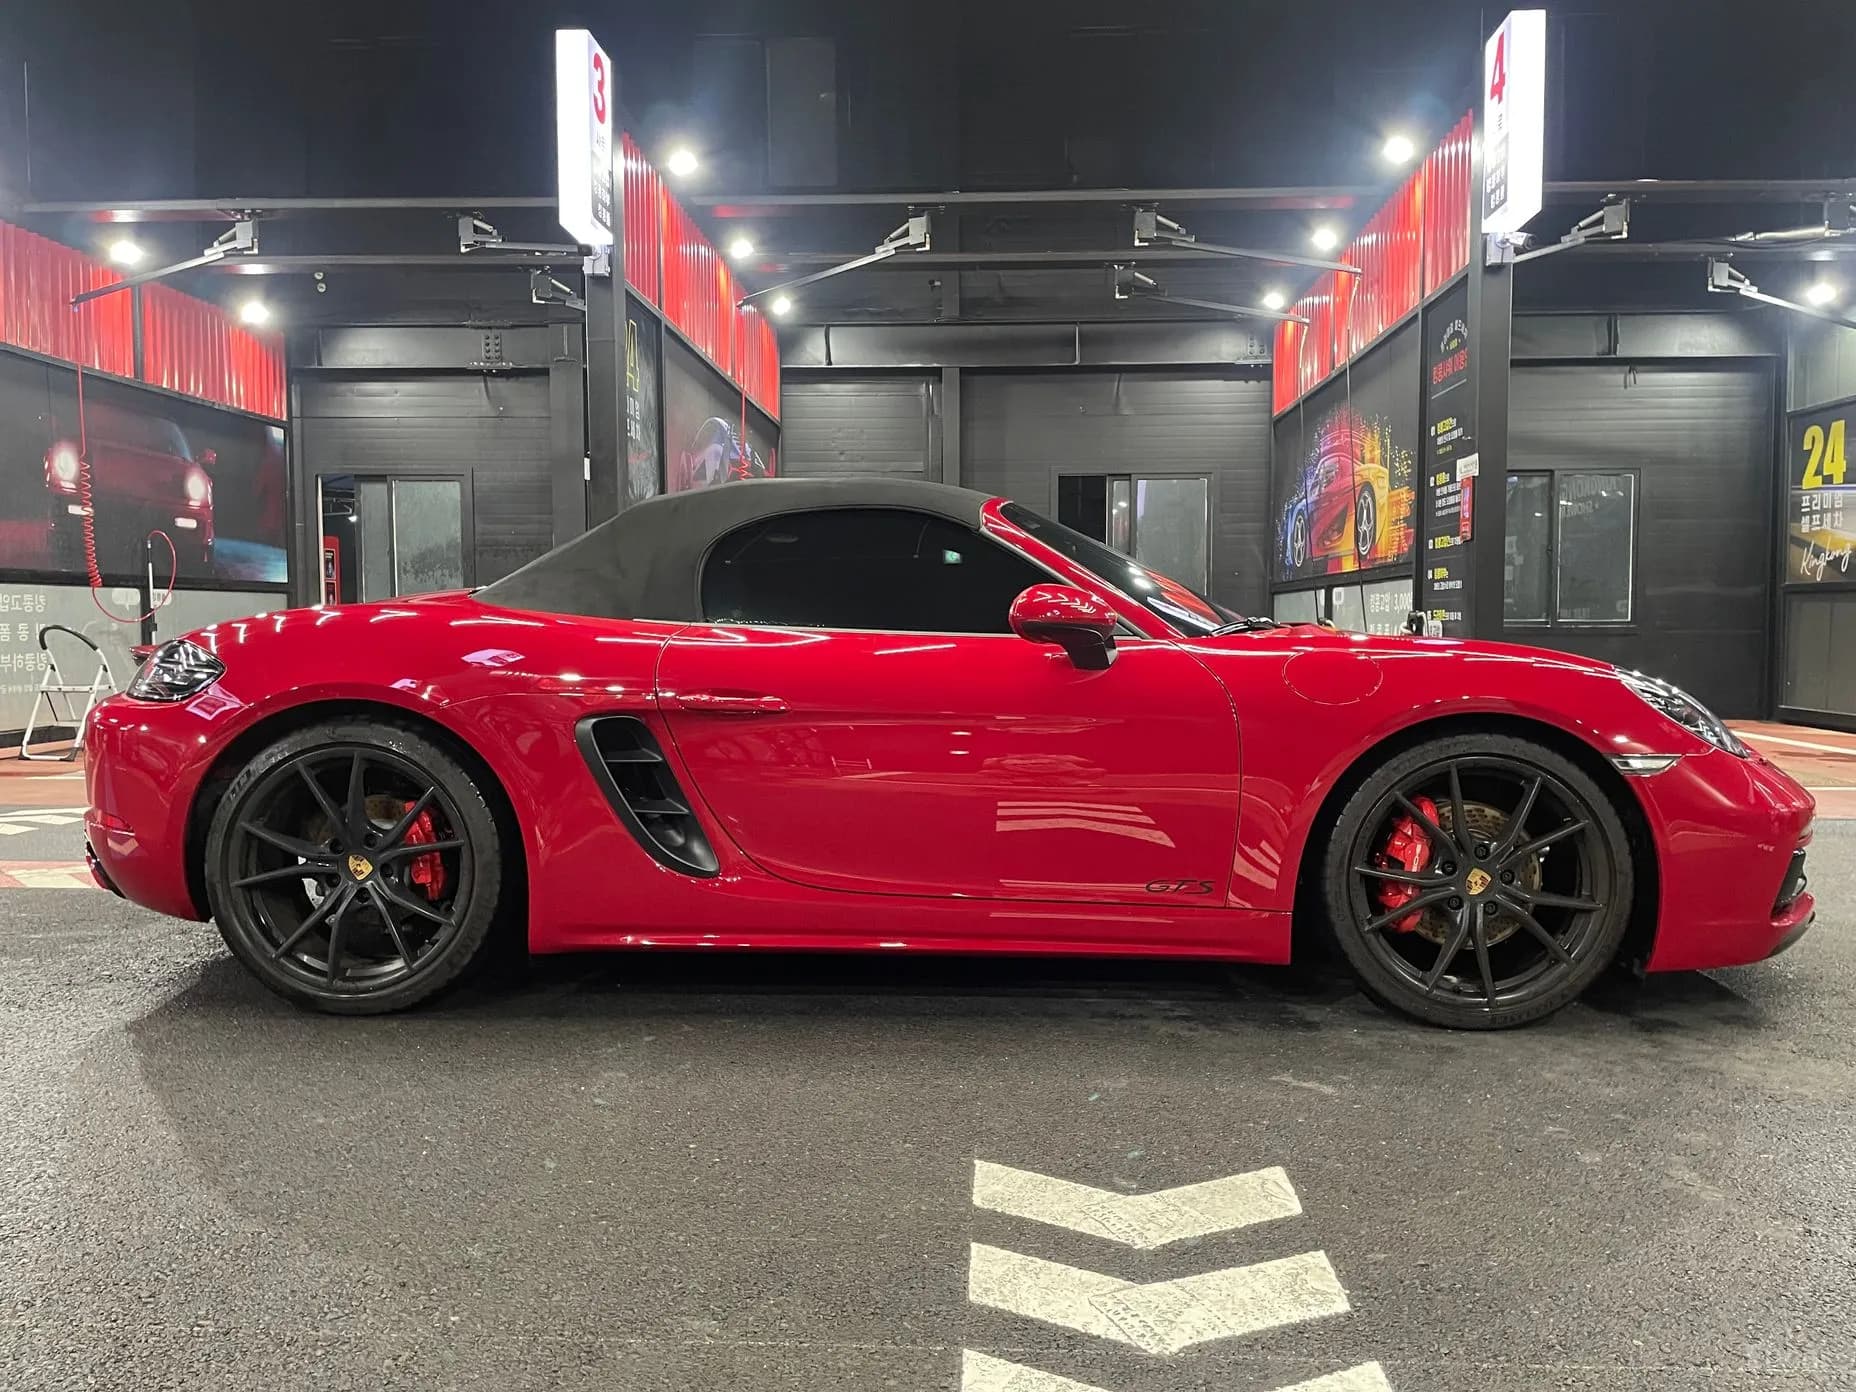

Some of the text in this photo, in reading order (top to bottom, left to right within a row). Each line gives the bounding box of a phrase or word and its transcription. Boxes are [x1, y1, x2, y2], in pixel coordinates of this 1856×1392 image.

[593, 52, 606, 125] 3
[1490, 31, 1506, 104] 4
[1802, 420, 1847, 489] 24
[1801, 491, 1843, 512] 프리미엄
[1801, 511, 1844, 533] 셀프세차
[1145, 879, 1216, 895] GTS
